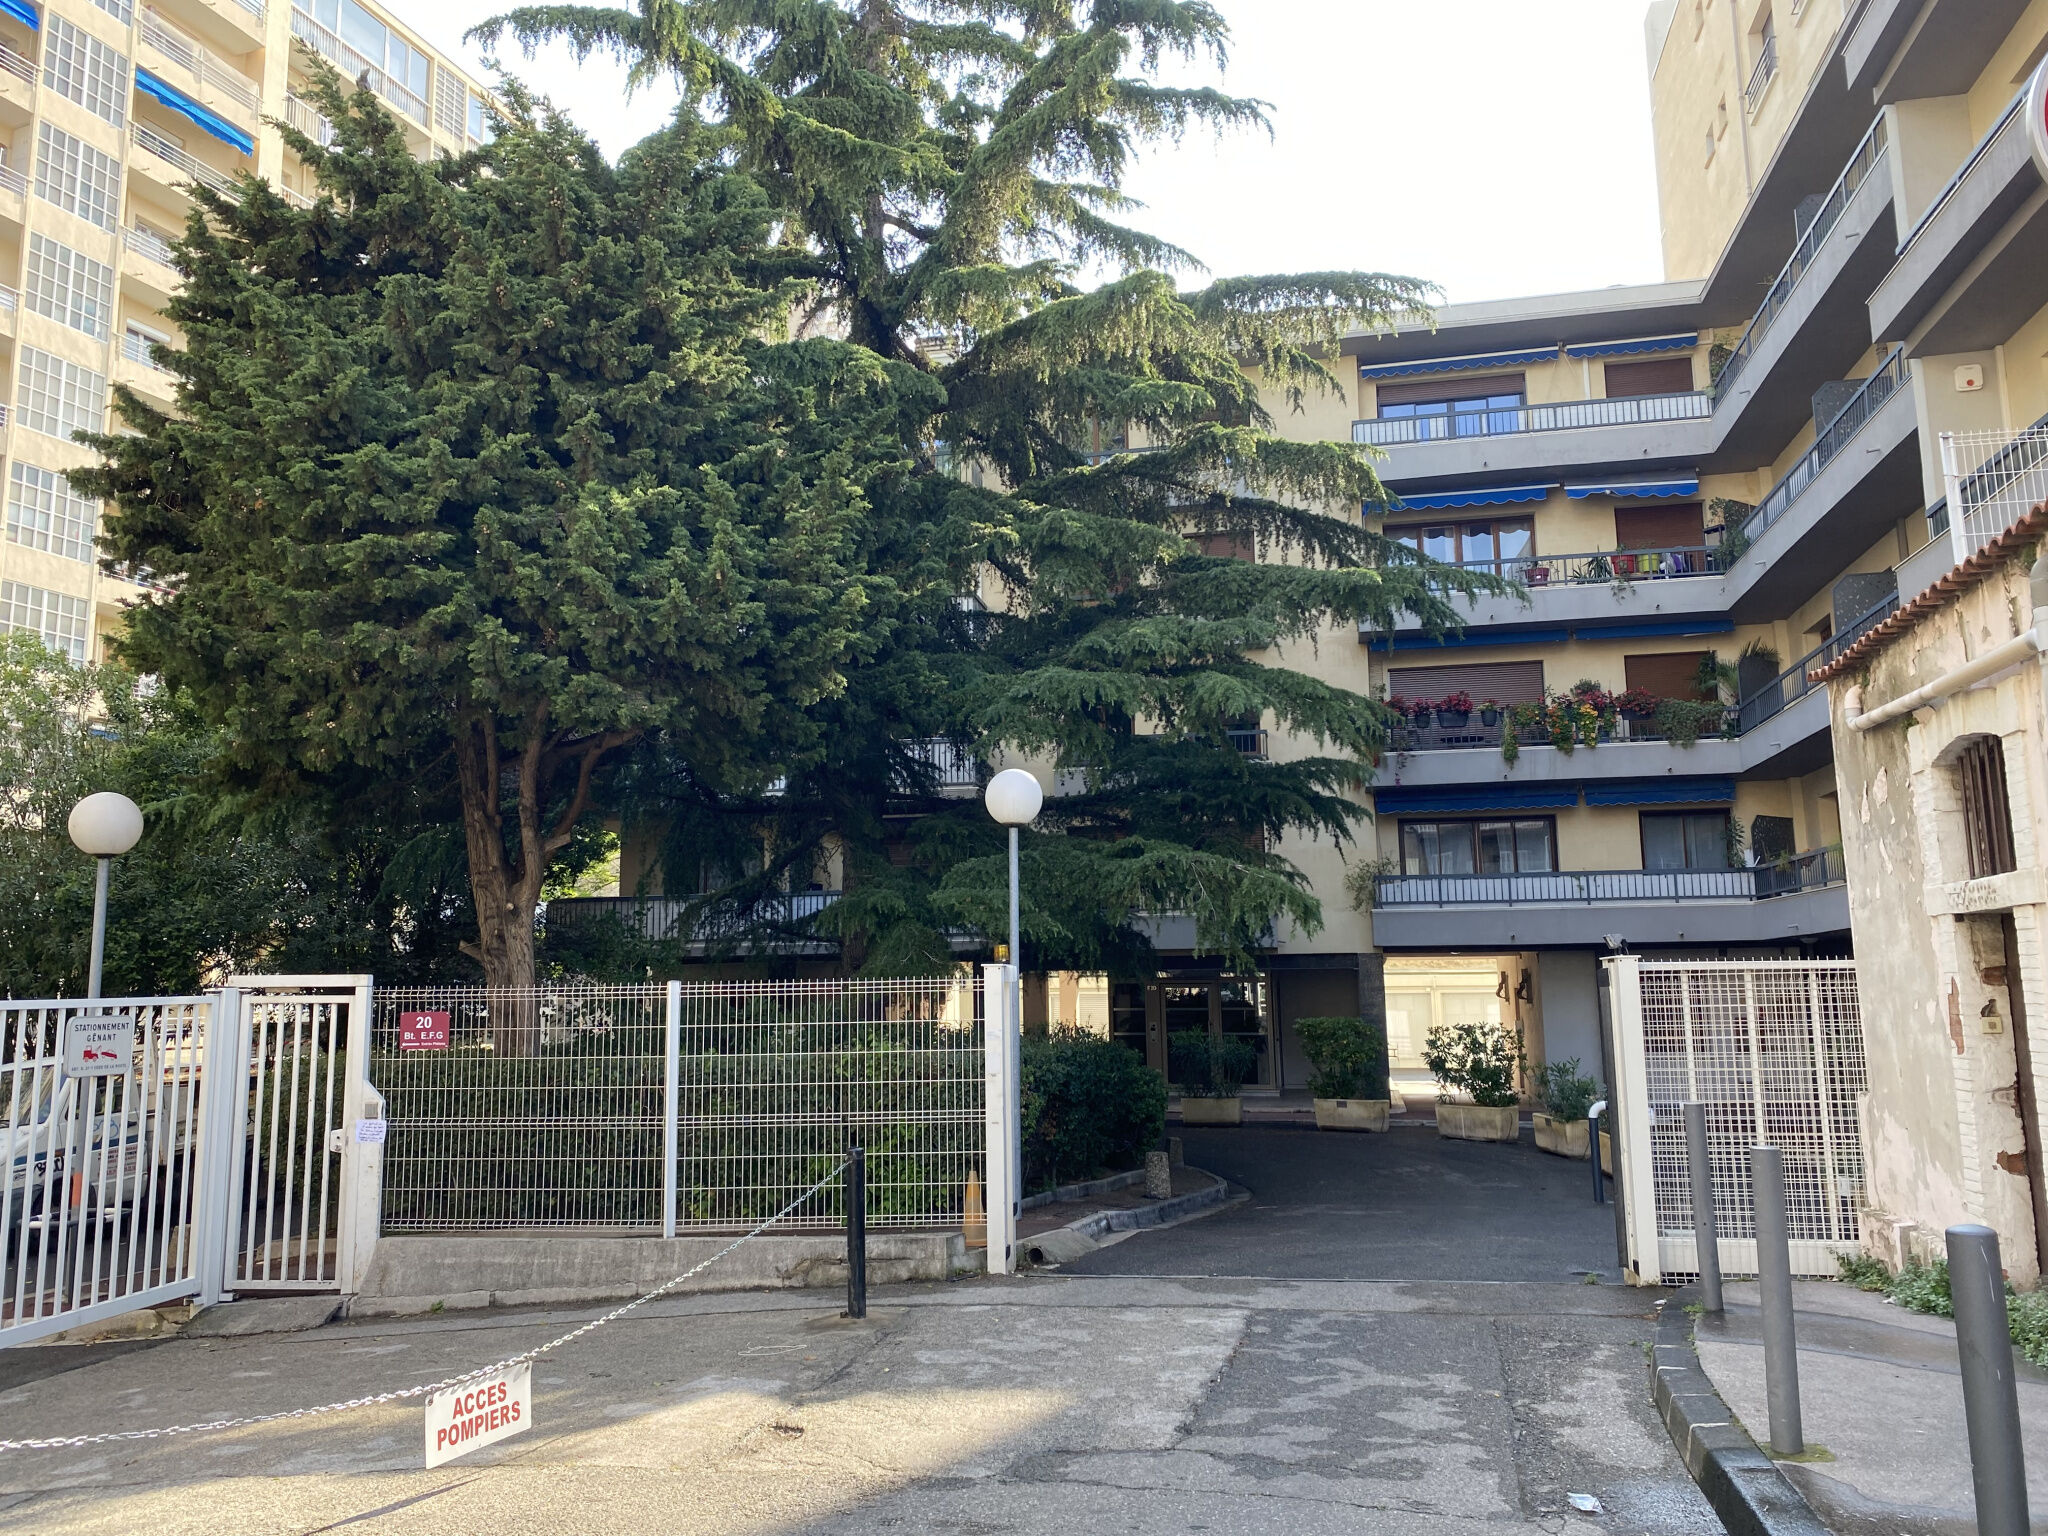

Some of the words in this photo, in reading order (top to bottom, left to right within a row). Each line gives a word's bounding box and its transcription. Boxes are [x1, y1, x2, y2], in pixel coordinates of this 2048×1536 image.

[74, 1022, 130, 1032] STATIONNEMENT
[415, 1016, 432, 1029] 20
[86, 1033, 117, 1042] GÊNANT
[404, 1032, 416, 1040] Bt.
[420, 1031, 444, 1040] E.F.G
[452, 1381, 507, 1420] ACCES
[437, 1400, 521, 1451] POMPIERS
